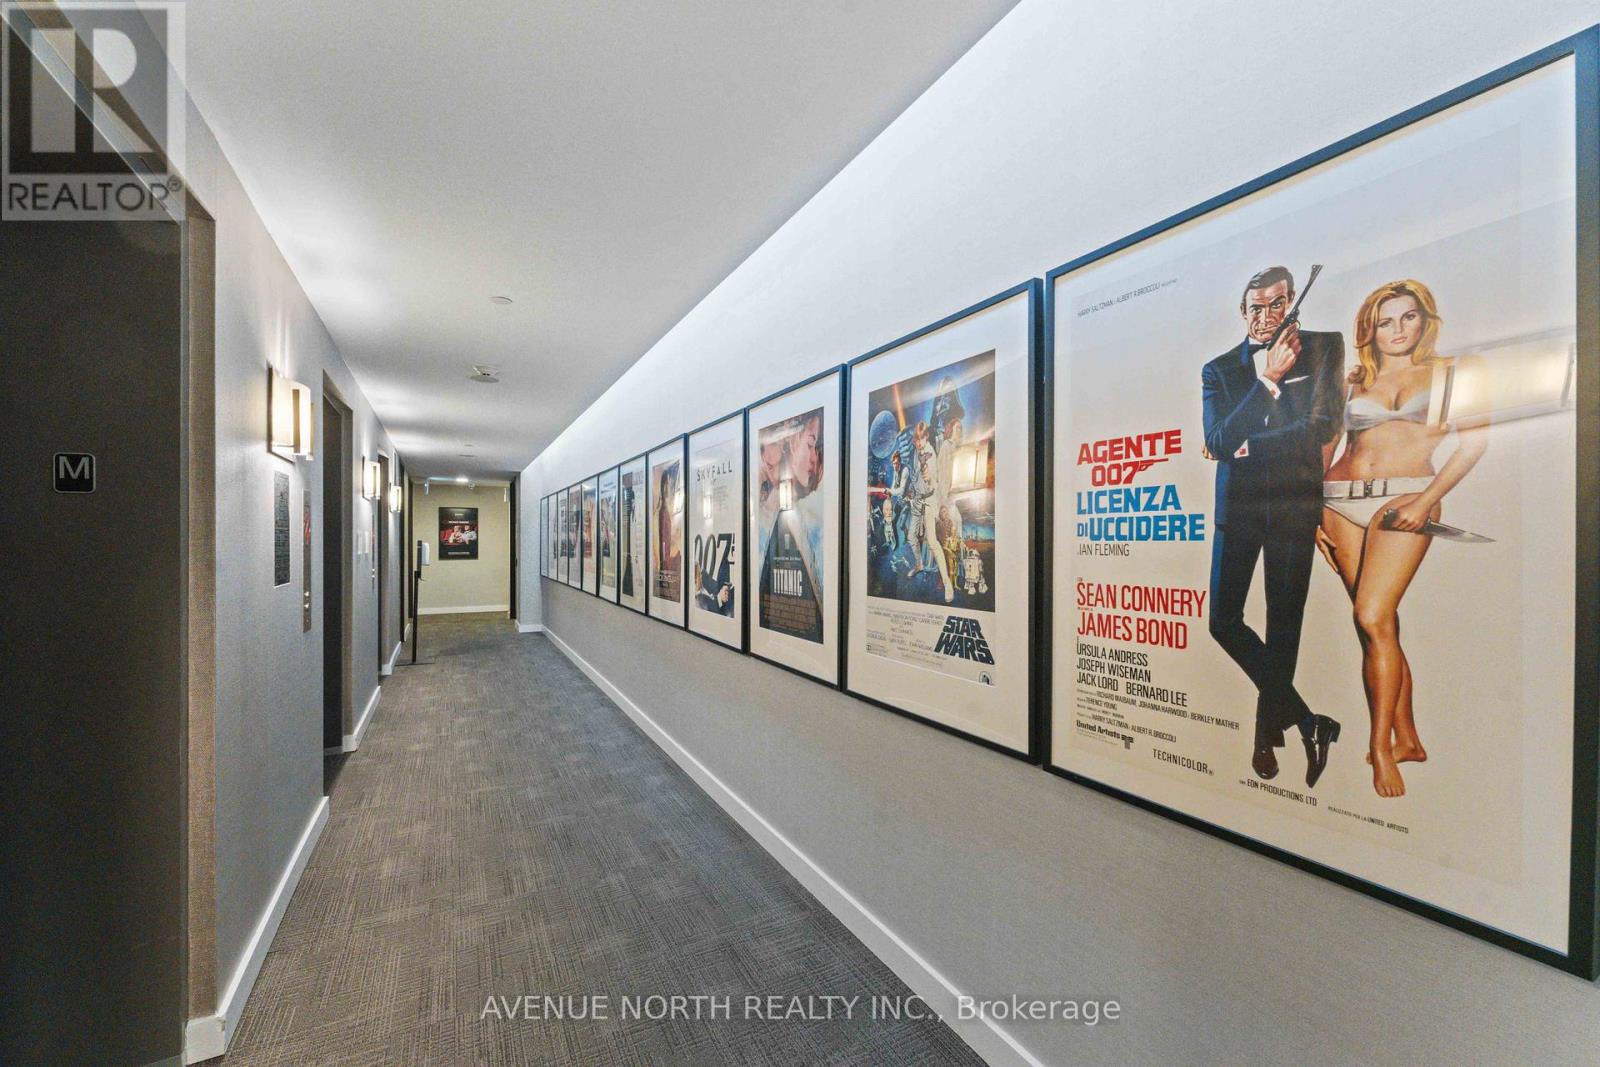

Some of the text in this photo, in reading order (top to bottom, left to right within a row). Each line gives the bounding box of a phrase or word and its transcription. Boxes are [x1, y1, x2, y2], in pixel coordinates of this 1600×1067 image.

[1077, 429, 1182, 465] AGENTE
[59, 455, 90, 480] M
[697, 459, 733, 482] SKYFALL
[1092, 460, 1143, 486] 007
[1077, 485, 1182, 515] LICENZA
[1077, 513, 1205, 542] DI UCCIDERE
[1079, 543, 1130, 557] IAN FLEMING
[773, 568, 803, 597] TITANIC
[1076, 582, 1207, 618] SEAN CONNERY
[943, 615, 985, 639] STAR
[1077, 611, 1188, 650] JAMES BOND
[934, 632, 995, 665] WARS
[1076, 643, 1148, 667] URSULA ANDRESS
[1076, 657, 1151, 683] JOSEPH WISEMAN
[1076, 672, 1097, 686] JACK
[1097, 675, 1119, 692] LORD
[1126, 682, 1169, 703] BERNARD
[1170, 690, 1188, 707] LEE
[1076, 720, 1096, 732] United
[1097, 726, 1121, 739] Artists
[1190, 712, 1215, 725] BERKLEY
[1215, 718, 1240, 730] MATHER
[1153, 748, 1208, 774] TECHNICOLOR
[1247, 778, 1259, 789] EON
[1259, 782, 1304, 803] PRODUCTIONS
